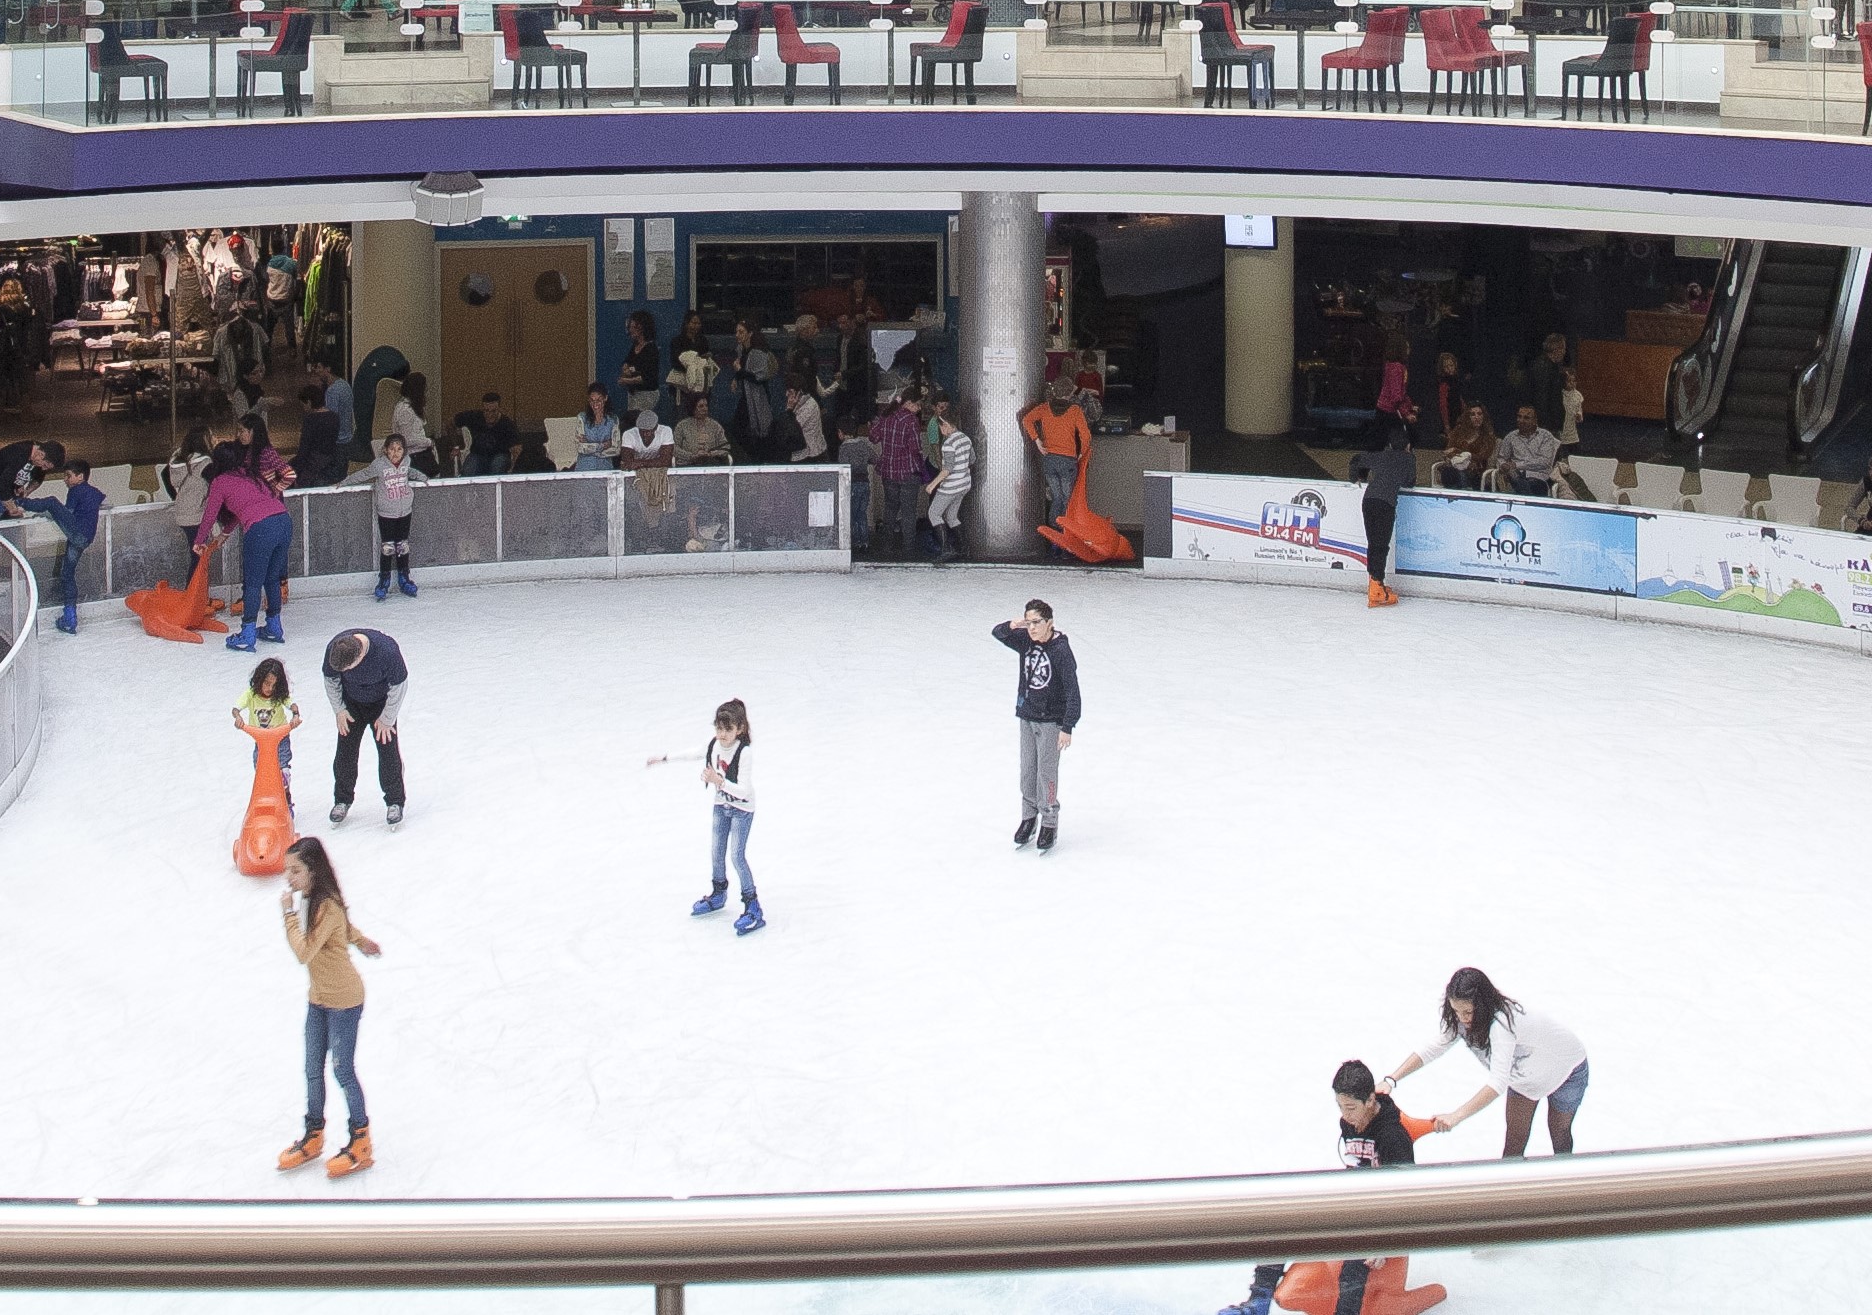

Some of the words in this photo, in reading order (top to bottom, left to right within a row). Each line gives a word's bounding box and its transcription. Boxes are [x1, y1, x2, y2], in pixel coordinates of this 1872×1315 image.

[1266, 506, 1315, 530] HIT
[1264, 526, 1289, 540] 91.4
[1294, 530, 1314, 544] FM
[1476, 537, 1541, 558] CHOICE
